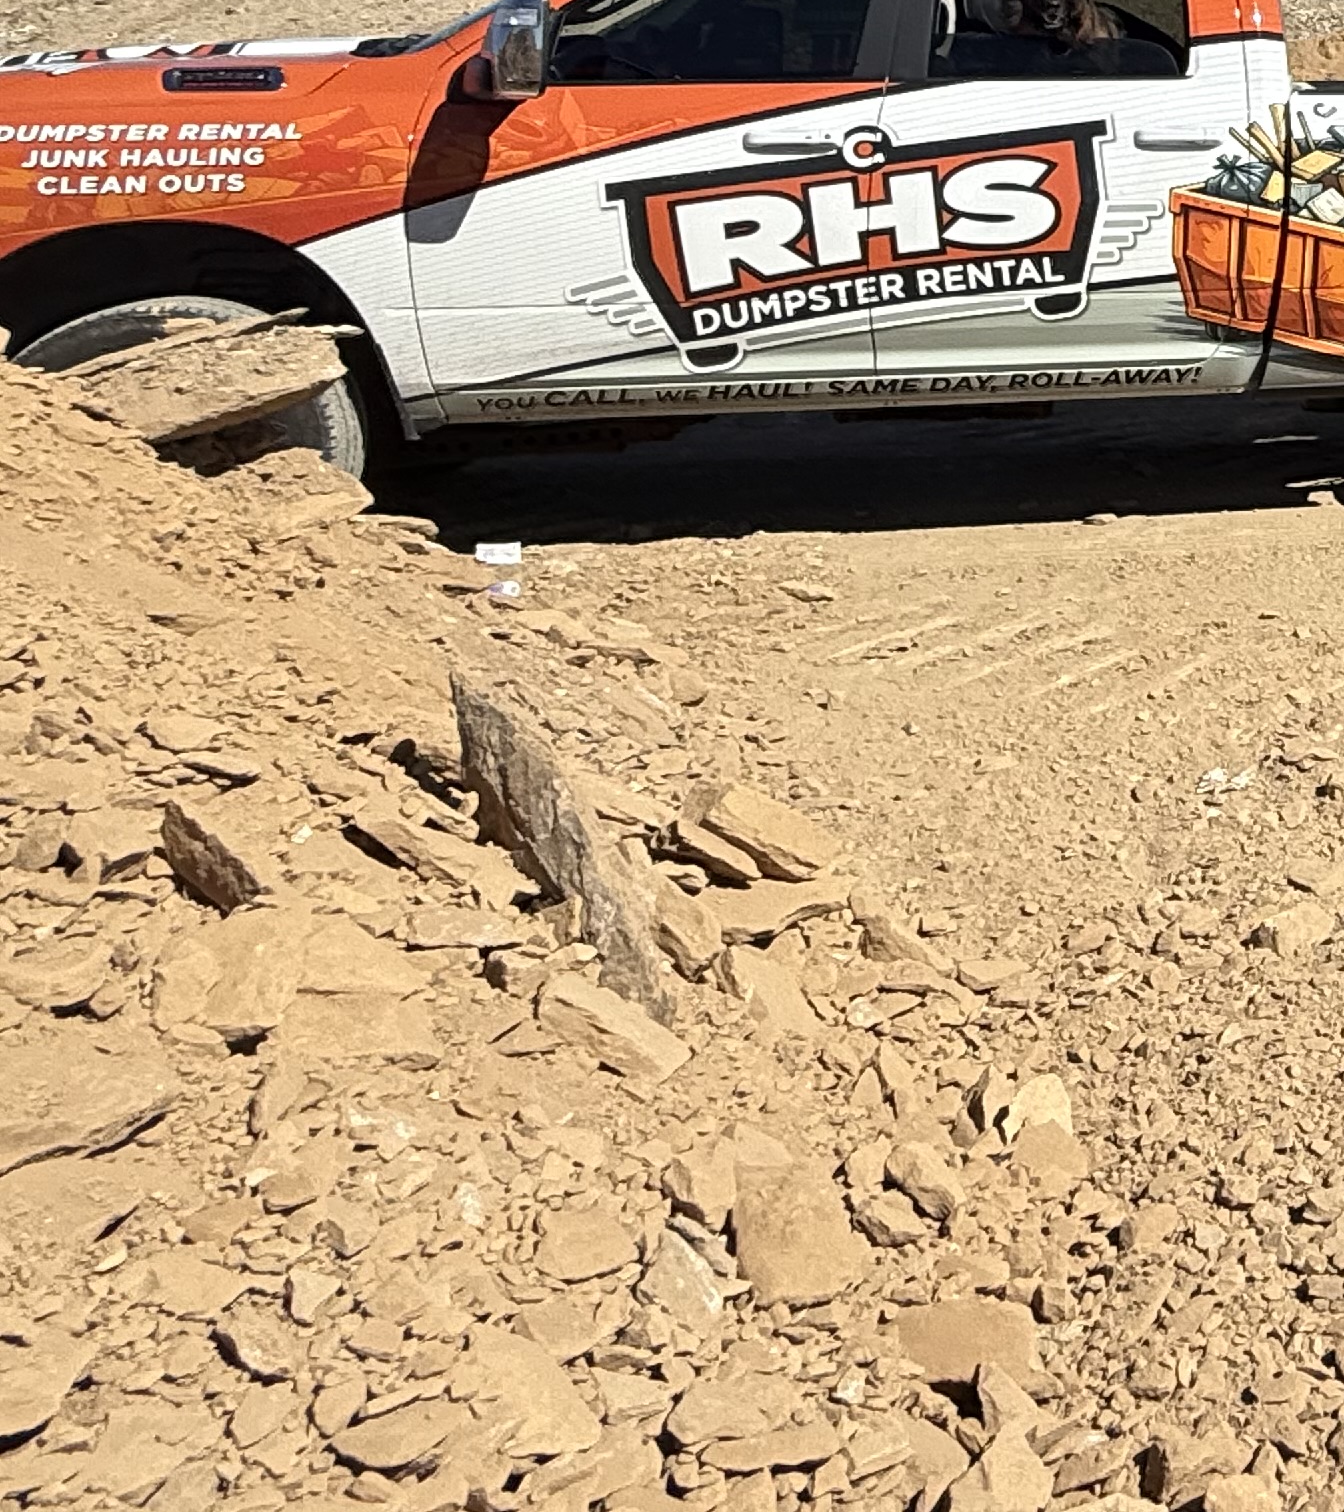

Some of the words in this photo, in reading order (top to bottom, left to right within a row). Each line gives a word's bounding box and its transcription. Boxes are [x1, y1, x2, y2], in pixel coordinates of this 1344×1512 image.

[0, 124, 169, 142] DUMPSTER
[177, 123, 303, 140] RENTAL
[21, 149, 110, 168] JUNK
[119, 147, 265, 167] HAULING
[37, 175, 147, 196] CLEAN
[159, 173, 246, 194] OUTS
[672, 157, 1059, 294] RHS
[693, 274, 905, 337] DUMPSTER
[916, 256, 1066, 290] RENTAL
[476, 395, 535, 412] YOU
[654, 389, 701, 403] WE
[706, 381, 814, 402] HAUL!
[828, 377, 921, 396] SAME
[929, 374, 998, 394] DAY,
[1007, 367, 1204, 389] ROLL-AWAY!
